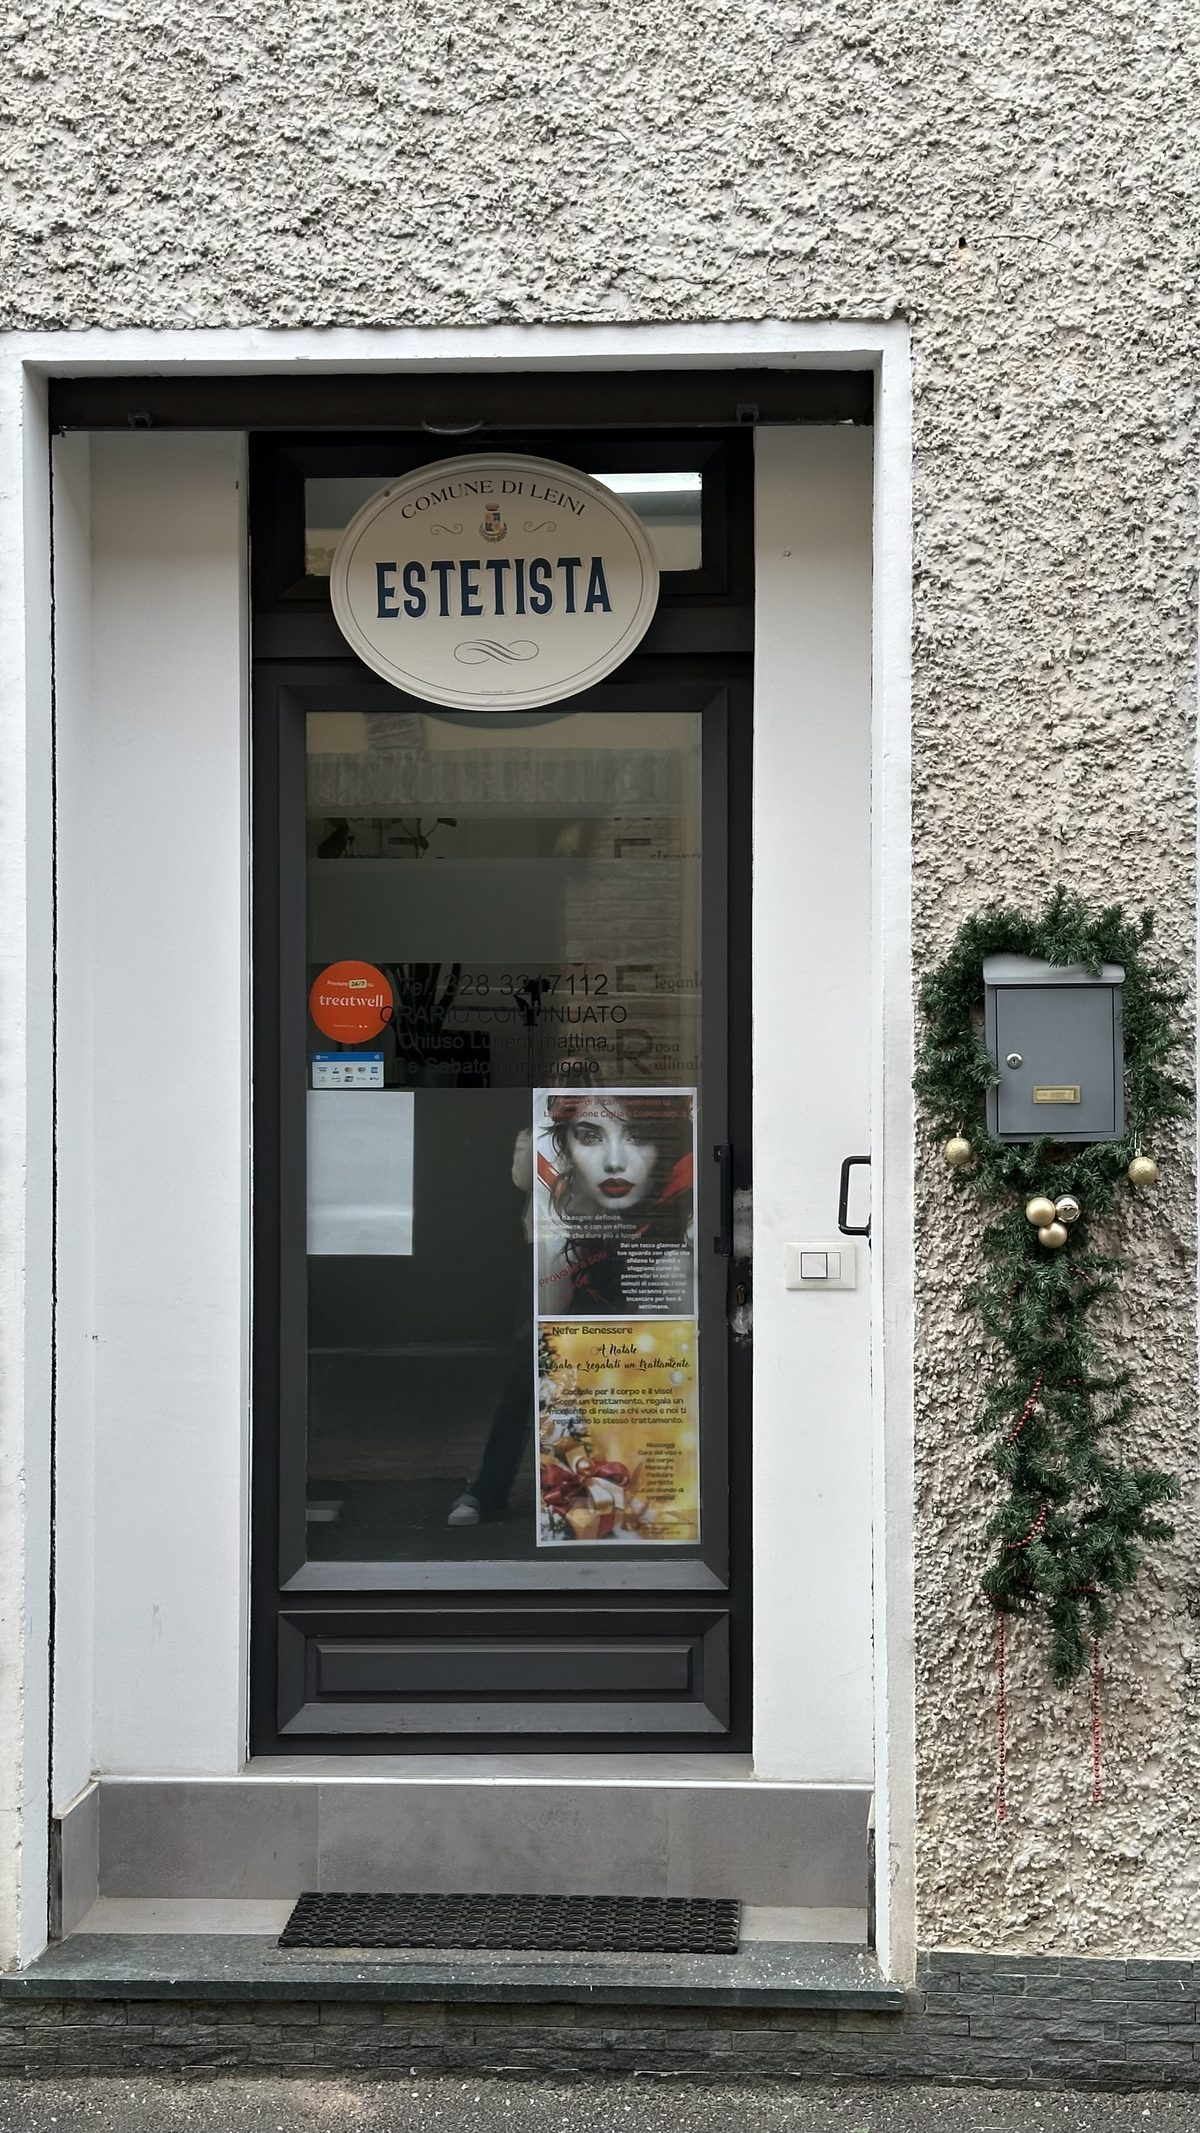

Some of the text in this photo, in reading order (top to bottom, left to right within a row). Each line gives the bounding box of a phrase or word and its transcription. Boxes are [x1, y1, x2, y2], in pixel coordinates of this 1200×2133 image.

[401, 480, 586, 519] COMUNE DI LEINI
[375, 556, 613, 620] ESTETISTA
[319, 994, 384, 1008] treatwell
[380, 1005, 470, 1024] ORARIO
[399, 1032, 464, 1049] Chiuso
[540, 1032, 607, 1049] mattina
[425, 1057, 489, 1074] Sabato
[552, 1326, 634, 1336] Nefer Benessere
[609, 1342, 639, 1356] Natale
[584, 1358, 621, 1372] regalati
[624, 1362, 635, 1370] un
[561, 1387, 593, 1395] Coccole
[594, 1388, 608, 1397] per
[616, 1388, 640, 1397] corpo
[654, 1387, 673, 1395] viso!
[646, 1398, 671, 1406] regala
[589, 1407, 596, 1415] di
[598, 1407, 619, 1415] relax
